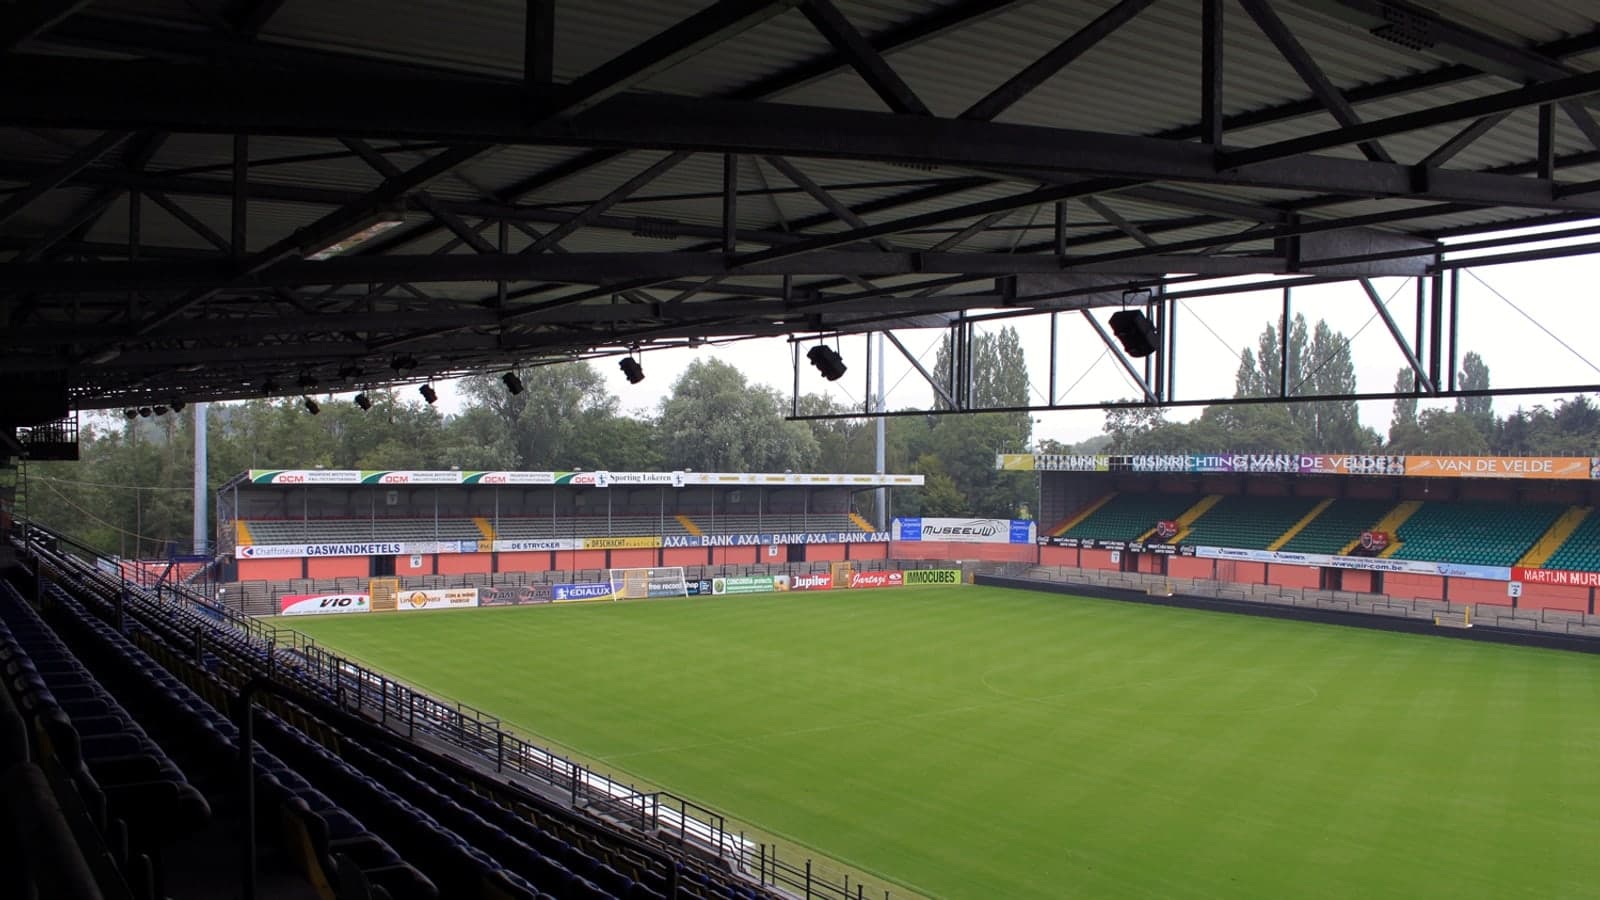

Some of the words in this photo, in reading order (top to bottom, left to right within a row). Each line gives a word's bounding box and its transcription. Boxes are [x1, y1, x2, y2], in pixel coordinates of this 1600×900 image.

[1251, 457, 1290, 468] VAN
[1301, 457, 1324, 469] DE
[1328, 457, 1387, 470] VELDE
[1436, 459, 1471, 472] VAN
[1475, 460, 1497, 473] DE
[1502, 460, 1553, 474] VELDE
[610, 473, 640, 483] Sporting
[643, 473, 672, 482] Lokeren
[663, 535, 689, 548] AXA
[701, 535, 734, 547] BANK
[737, 534, 761, 546] AXA
[773, 533, 803, 545] BANK
[806, 533, 828, 544] AXA
[838, 532, 867, 543] BANK
[870, 531, 890, 542] AXA
[306, 543, 401, 556] GASWANDKETELS
[511, 542, 521, 550] DE
[792, 575, 830, 588] Jupiler
[907, 570, 955, 583] IMMOCUBES
[1524, 569, 1567, 584] MARTIJN
[569, 587, 611, 597] EDIALUX
[662, 582, 682, 590] record
[320, 598, 352, 608] VIO
